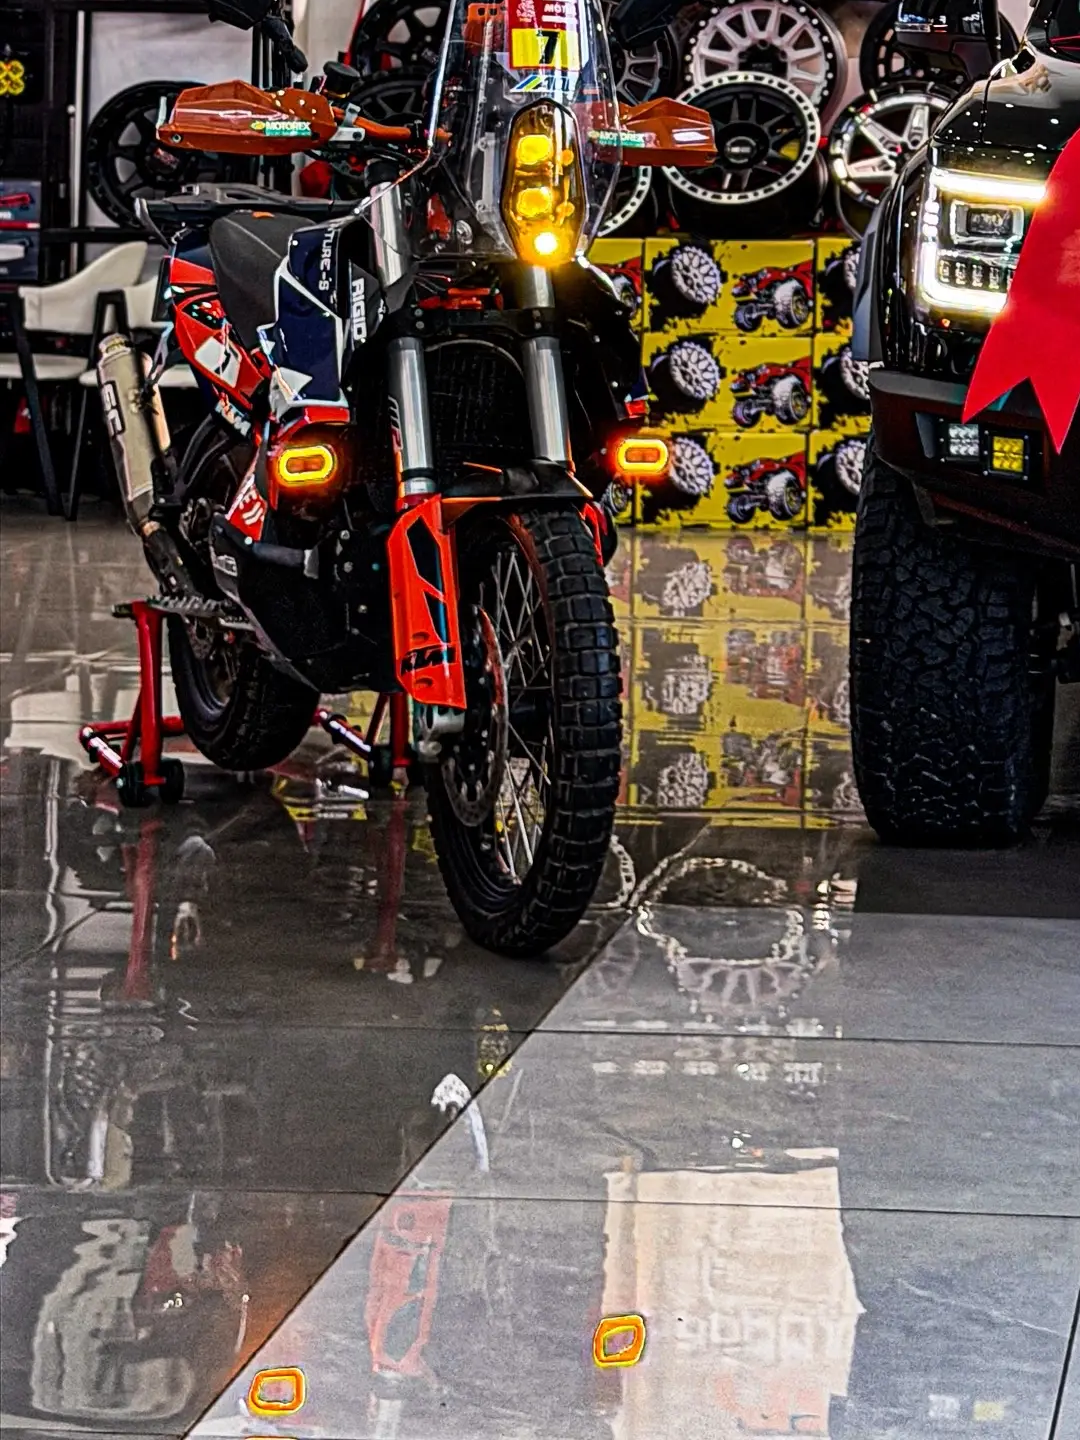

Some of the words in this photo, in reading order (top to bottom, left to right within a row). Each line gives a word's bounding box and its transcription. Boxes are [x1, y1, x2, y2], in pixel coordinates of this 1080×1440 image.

[536, 30, 560, 64] 7
[352, 277, 368, 341] RIGID
[401, 644, 457, 677] KTM
